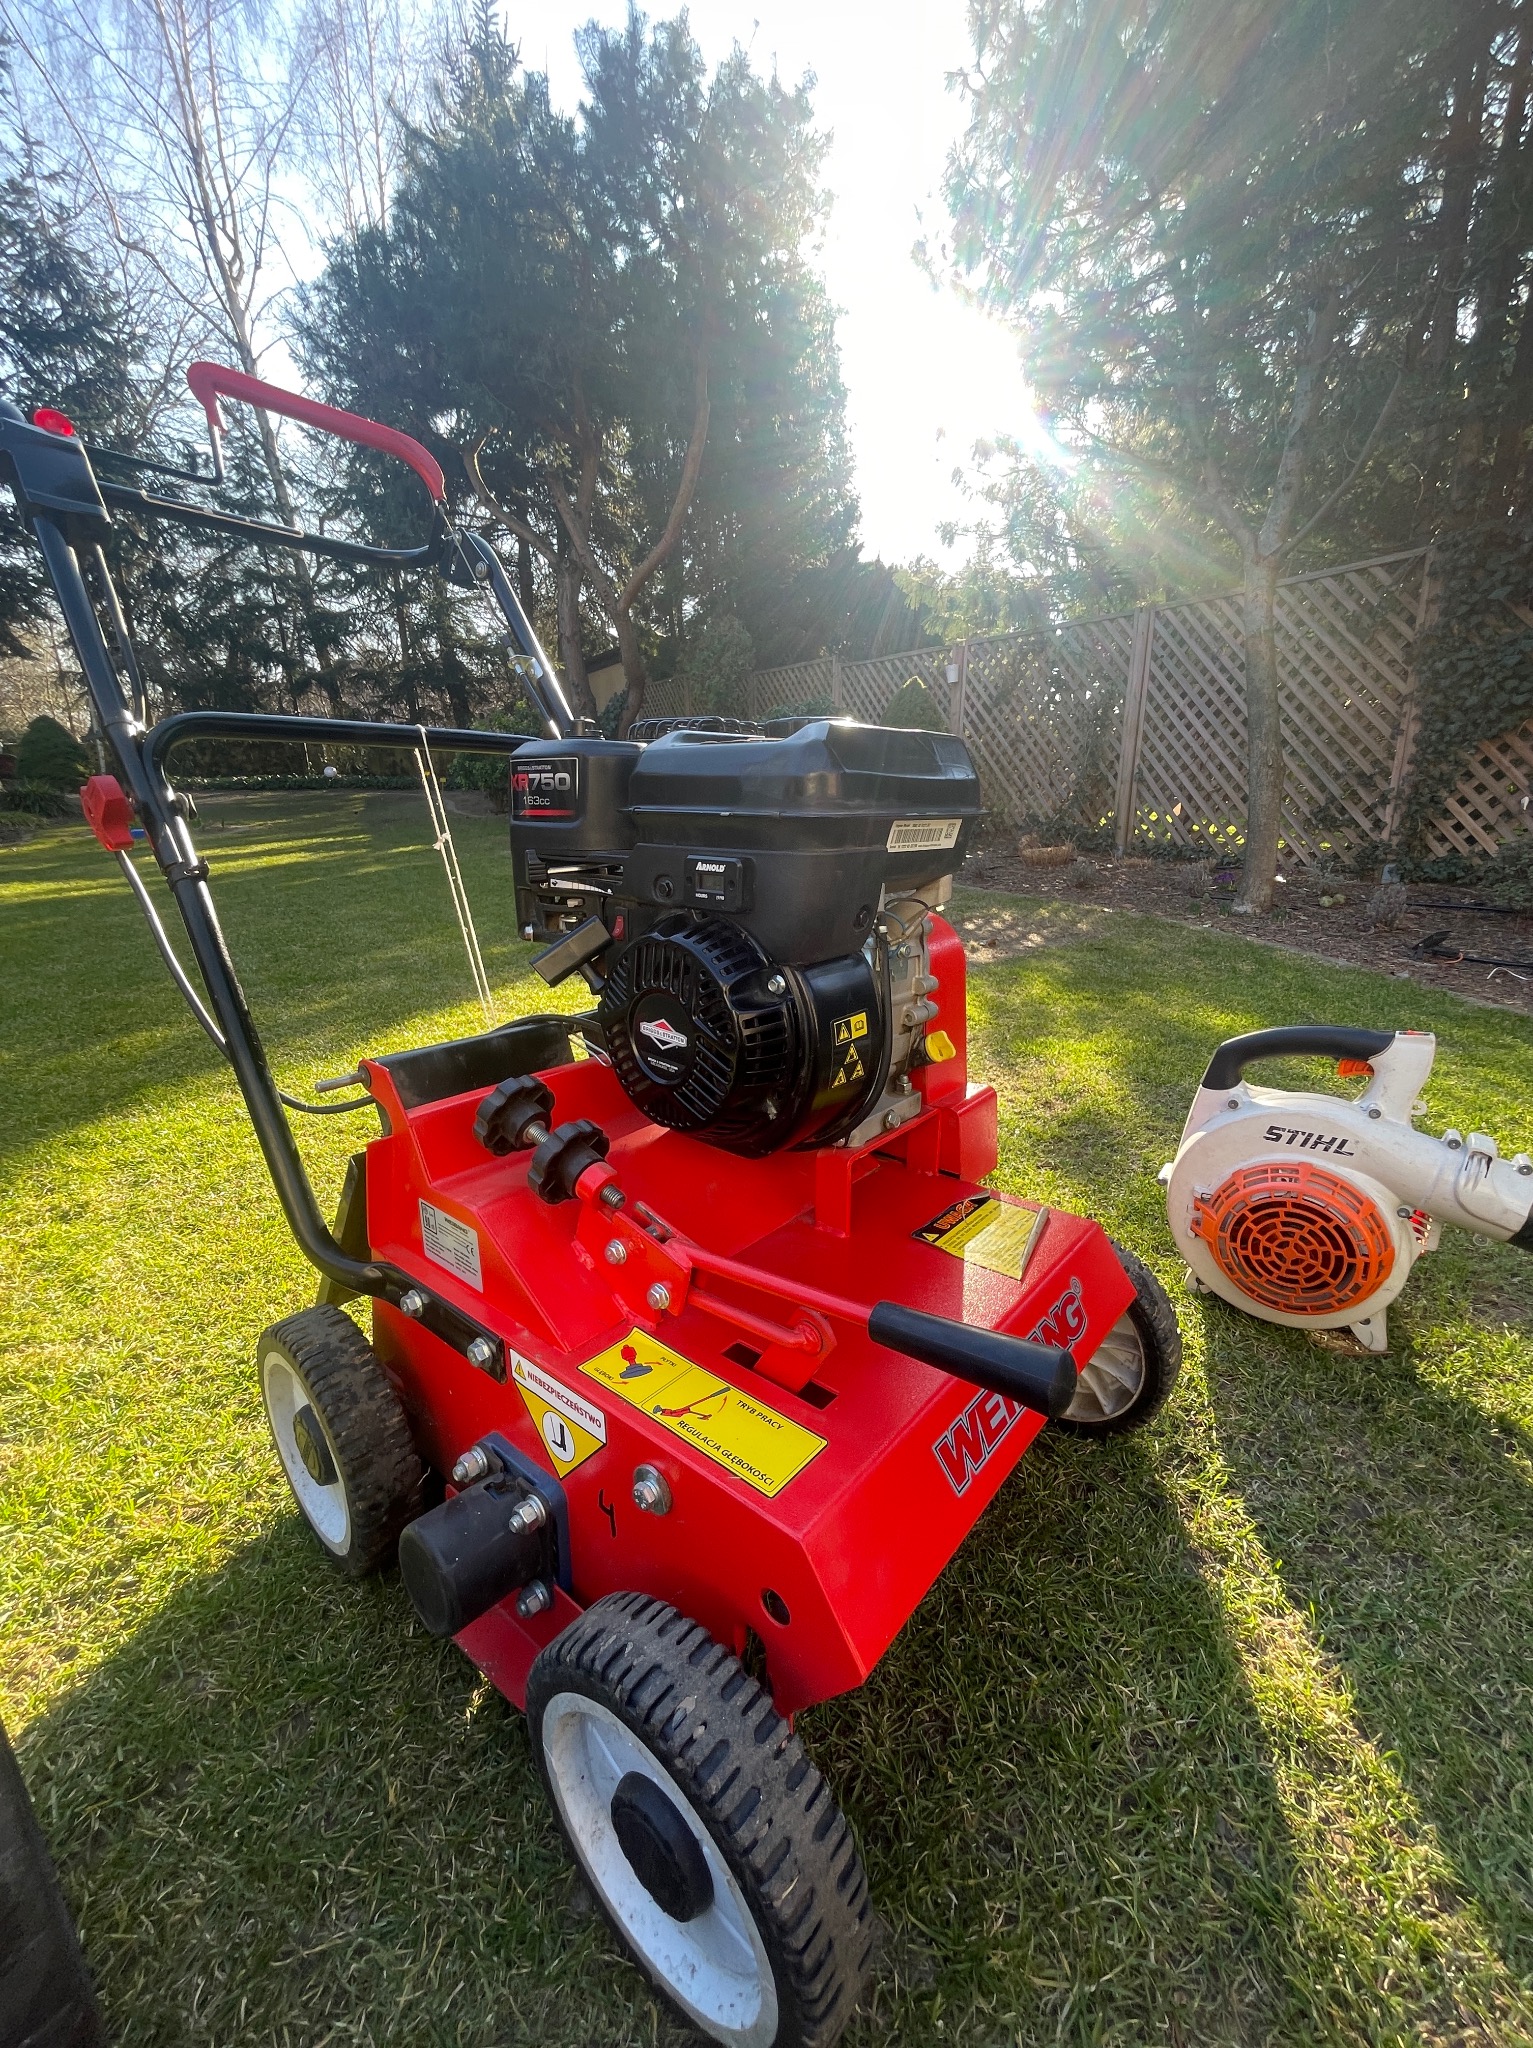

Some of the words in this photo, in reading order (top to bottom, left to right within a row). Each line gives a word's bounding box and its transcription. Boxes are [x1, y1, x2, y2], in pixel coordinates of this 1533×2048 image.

[512, 772, 571, 791] XR750
[523, 796, 551, 806] 163cc
[695, 861, 726, 873] ARNOLD
[1263, 1125, 1355, 1157] STIHL
[527, 1370, 602, 1429] NIEBEZPIECZEŃSTWO
[932, 1291, 1088, 1498] WEING
[736, 1399, 757, 1414] TRYB
[755, 1412, 785, 1431] PRACY
[677, 1420, 722, 1452] REGULACJA
[721, 1449, 775, 1487] GŁĘBOKOŚCI
